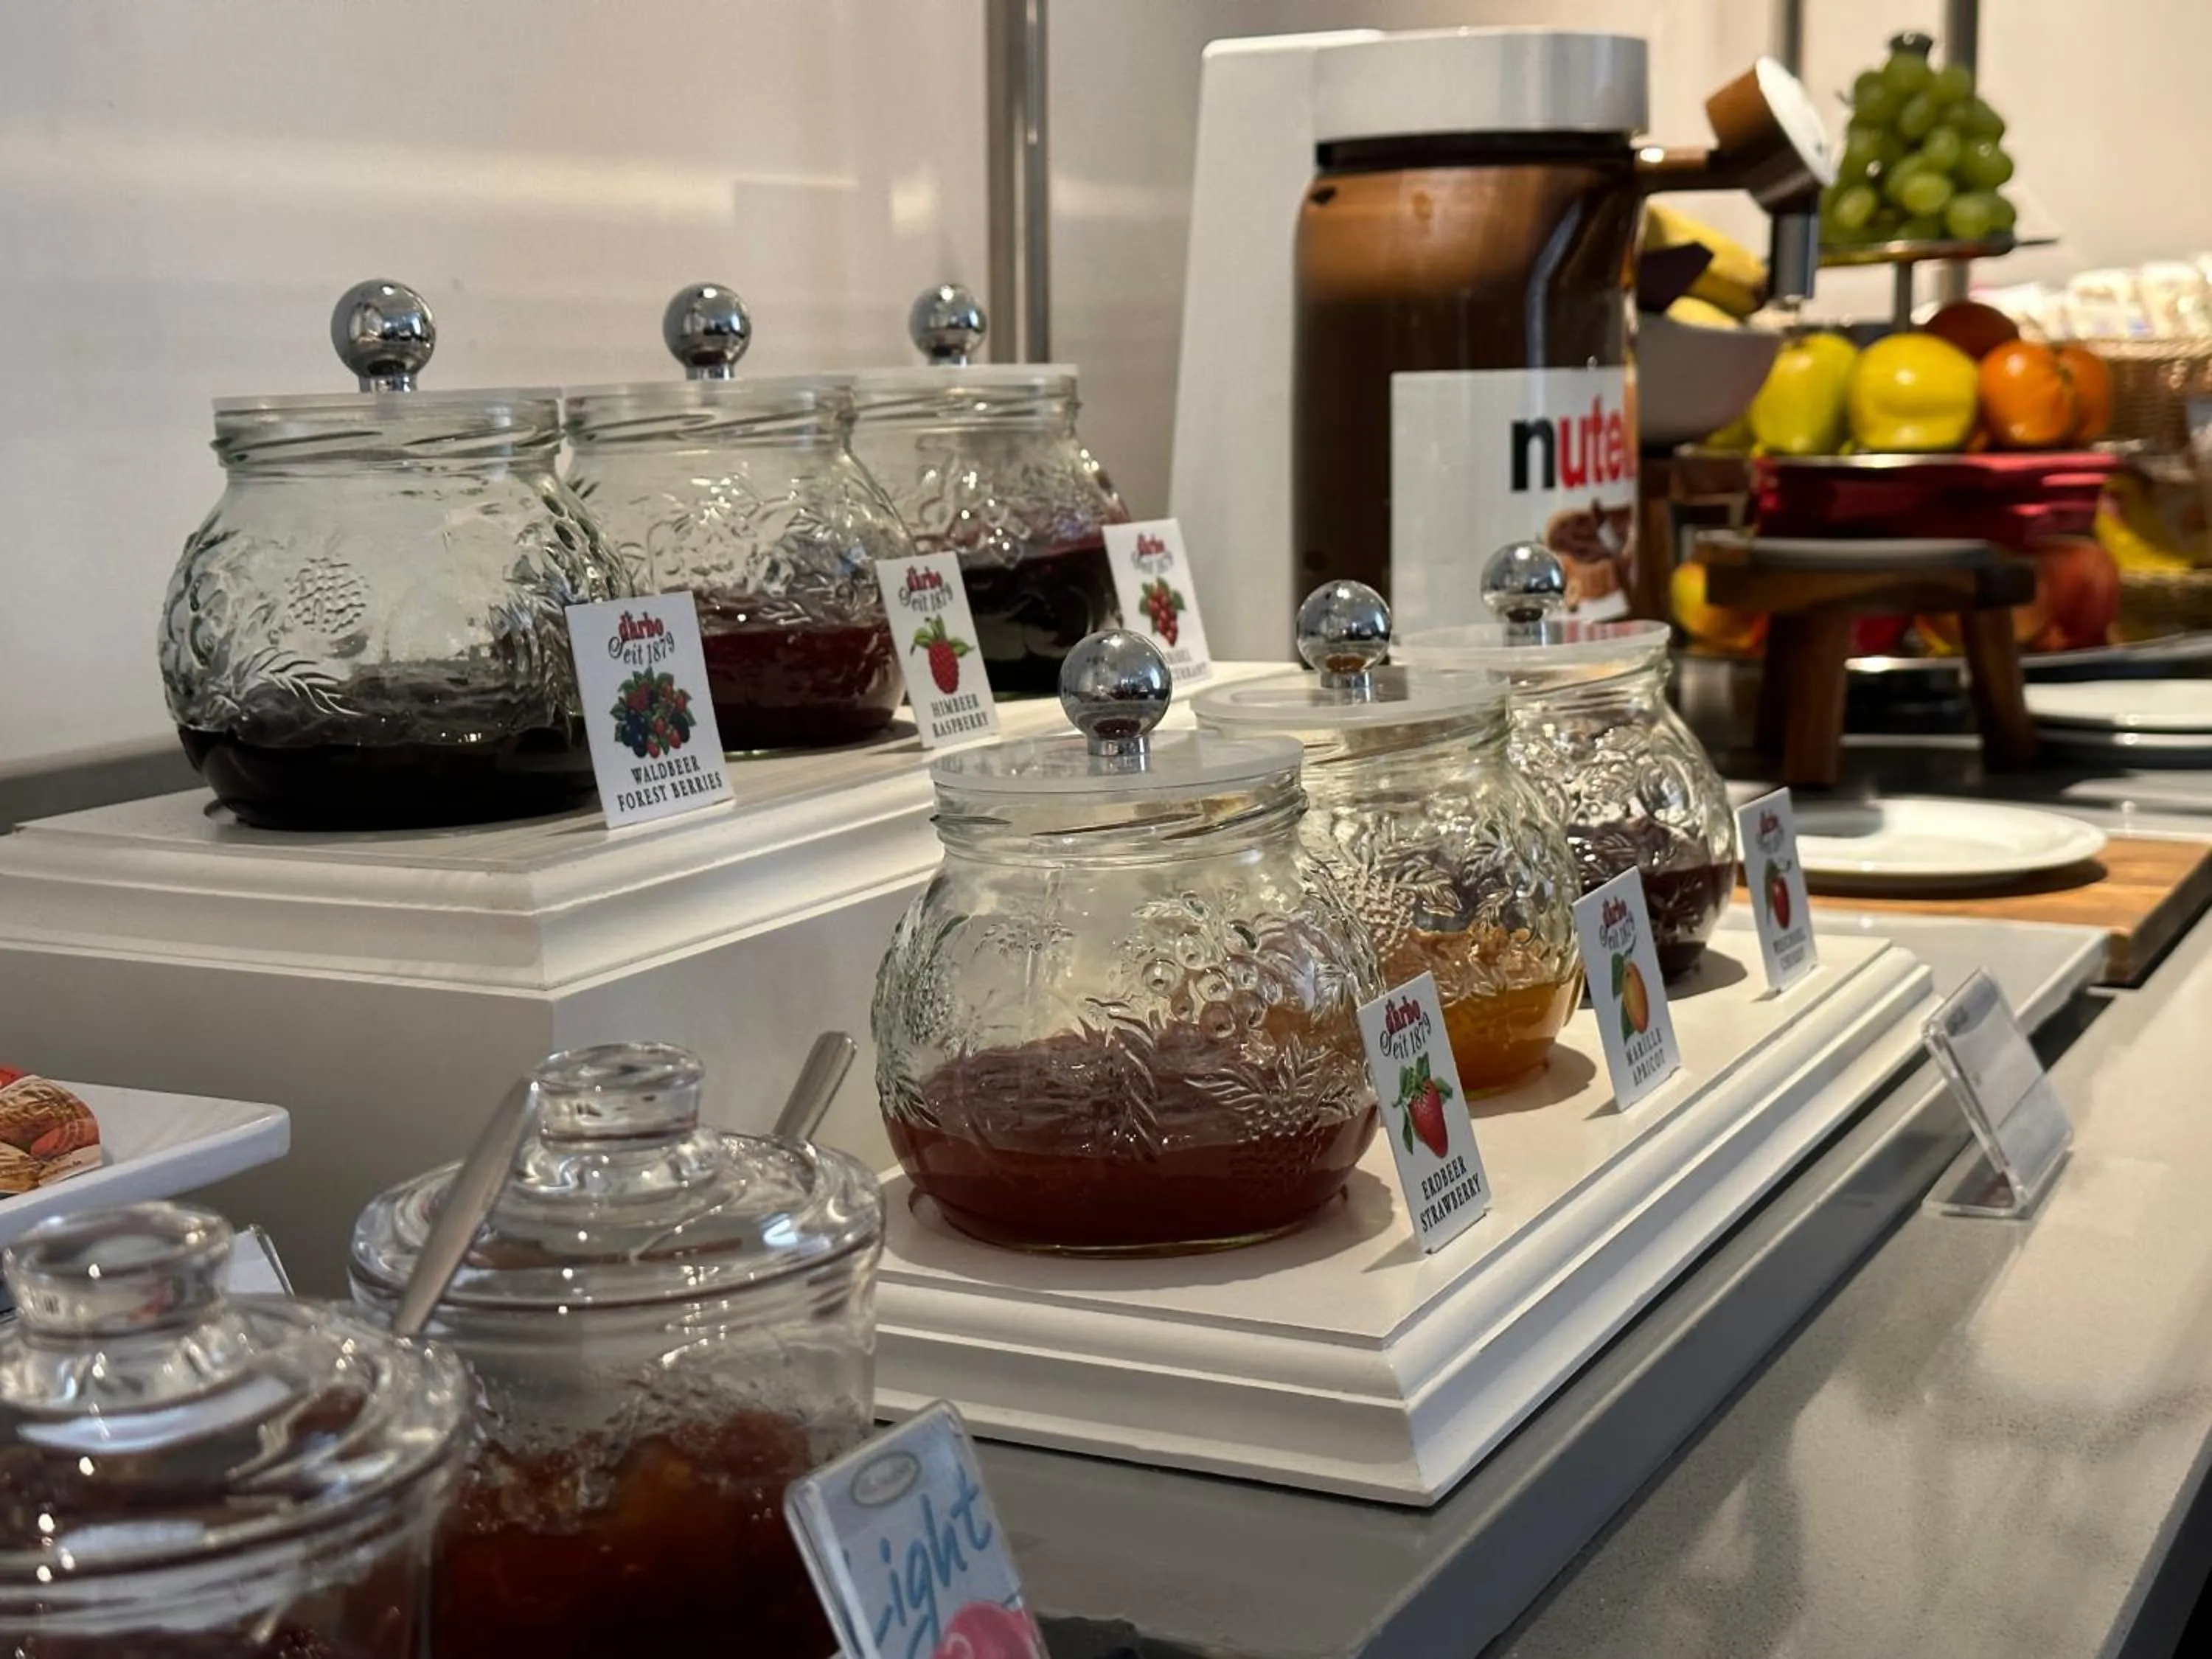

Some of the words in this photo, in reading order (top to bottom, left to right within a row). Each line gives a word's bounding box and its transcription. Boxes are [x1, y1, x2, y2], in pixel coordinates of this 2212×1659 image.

[608, 636, 644, 665] Seit
[647, 630, 675, 664] 1879
[931, 693, 981, 718] HIMBEER
[931, 712, 990, 738] RASPBERRY
[630, 754, 701, 785] WALDBEER
[616, 785, 668, 813] FOREST
[670, 771, 723, 799] BERRIES
[1379, 1030, 1409, 1060] Seit
[1409, 1011, 1433, 1054] 1879
[1626, 1027, 1663, 1068] MARILLE
[1632, 1048, 1666, 1088] APRICOT
[1420, 1155, 1467, 1202] ERDBEER
[1419, 1172, 1481, 1234] STRAWBERRY
